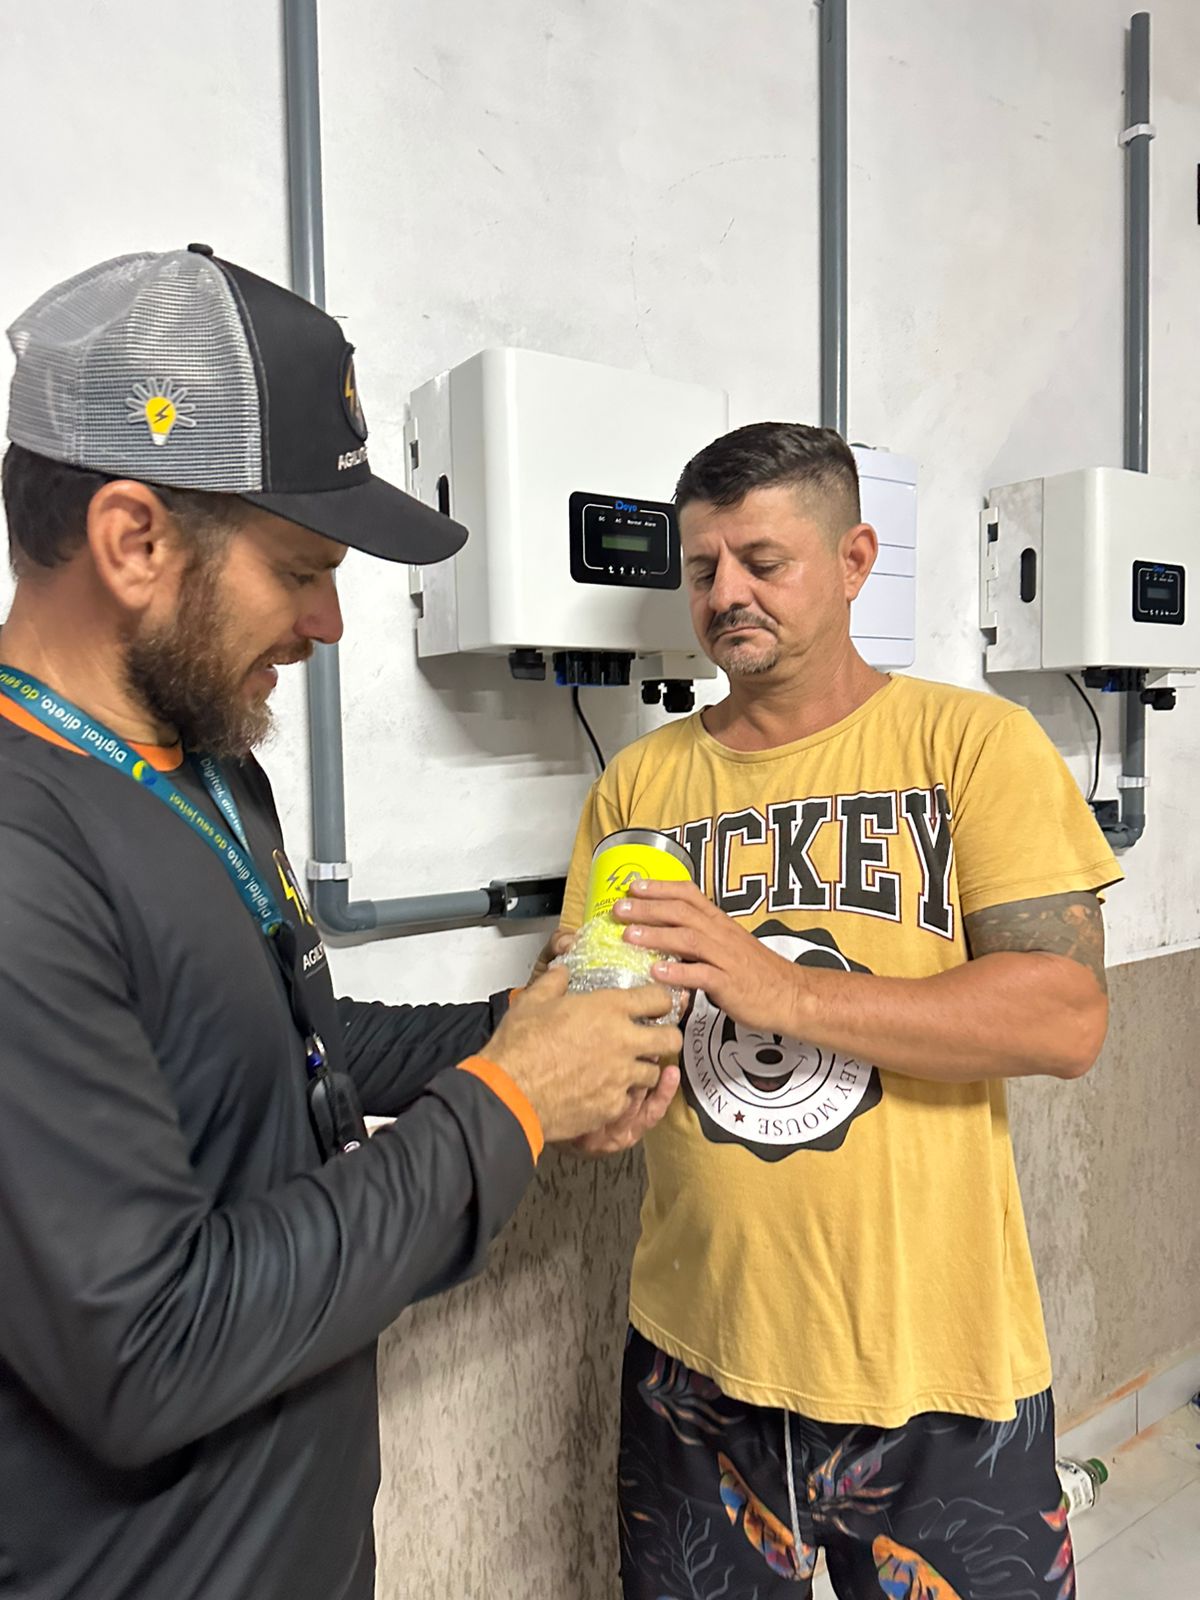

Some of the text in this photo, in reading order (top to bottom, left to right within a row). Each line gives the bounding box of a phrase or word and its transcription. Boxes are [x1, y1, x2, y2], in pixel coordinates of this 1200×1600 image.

[20, 684, 40, 700] do
[41, 694, 82, 730] direto,
[81, 724, 128, 763] Digital,
[196, 817, 214, 837] seu
[214, 834, 228, 850] do
[227, 846, 251, 881] direto,
[661, 783, 954, 941] ICKEY
[244, 877, 272, 918] Digital,
[692, 1013, 729, 1115] NEW YORK
[757, 1096, 839, 1136] MOUSE
